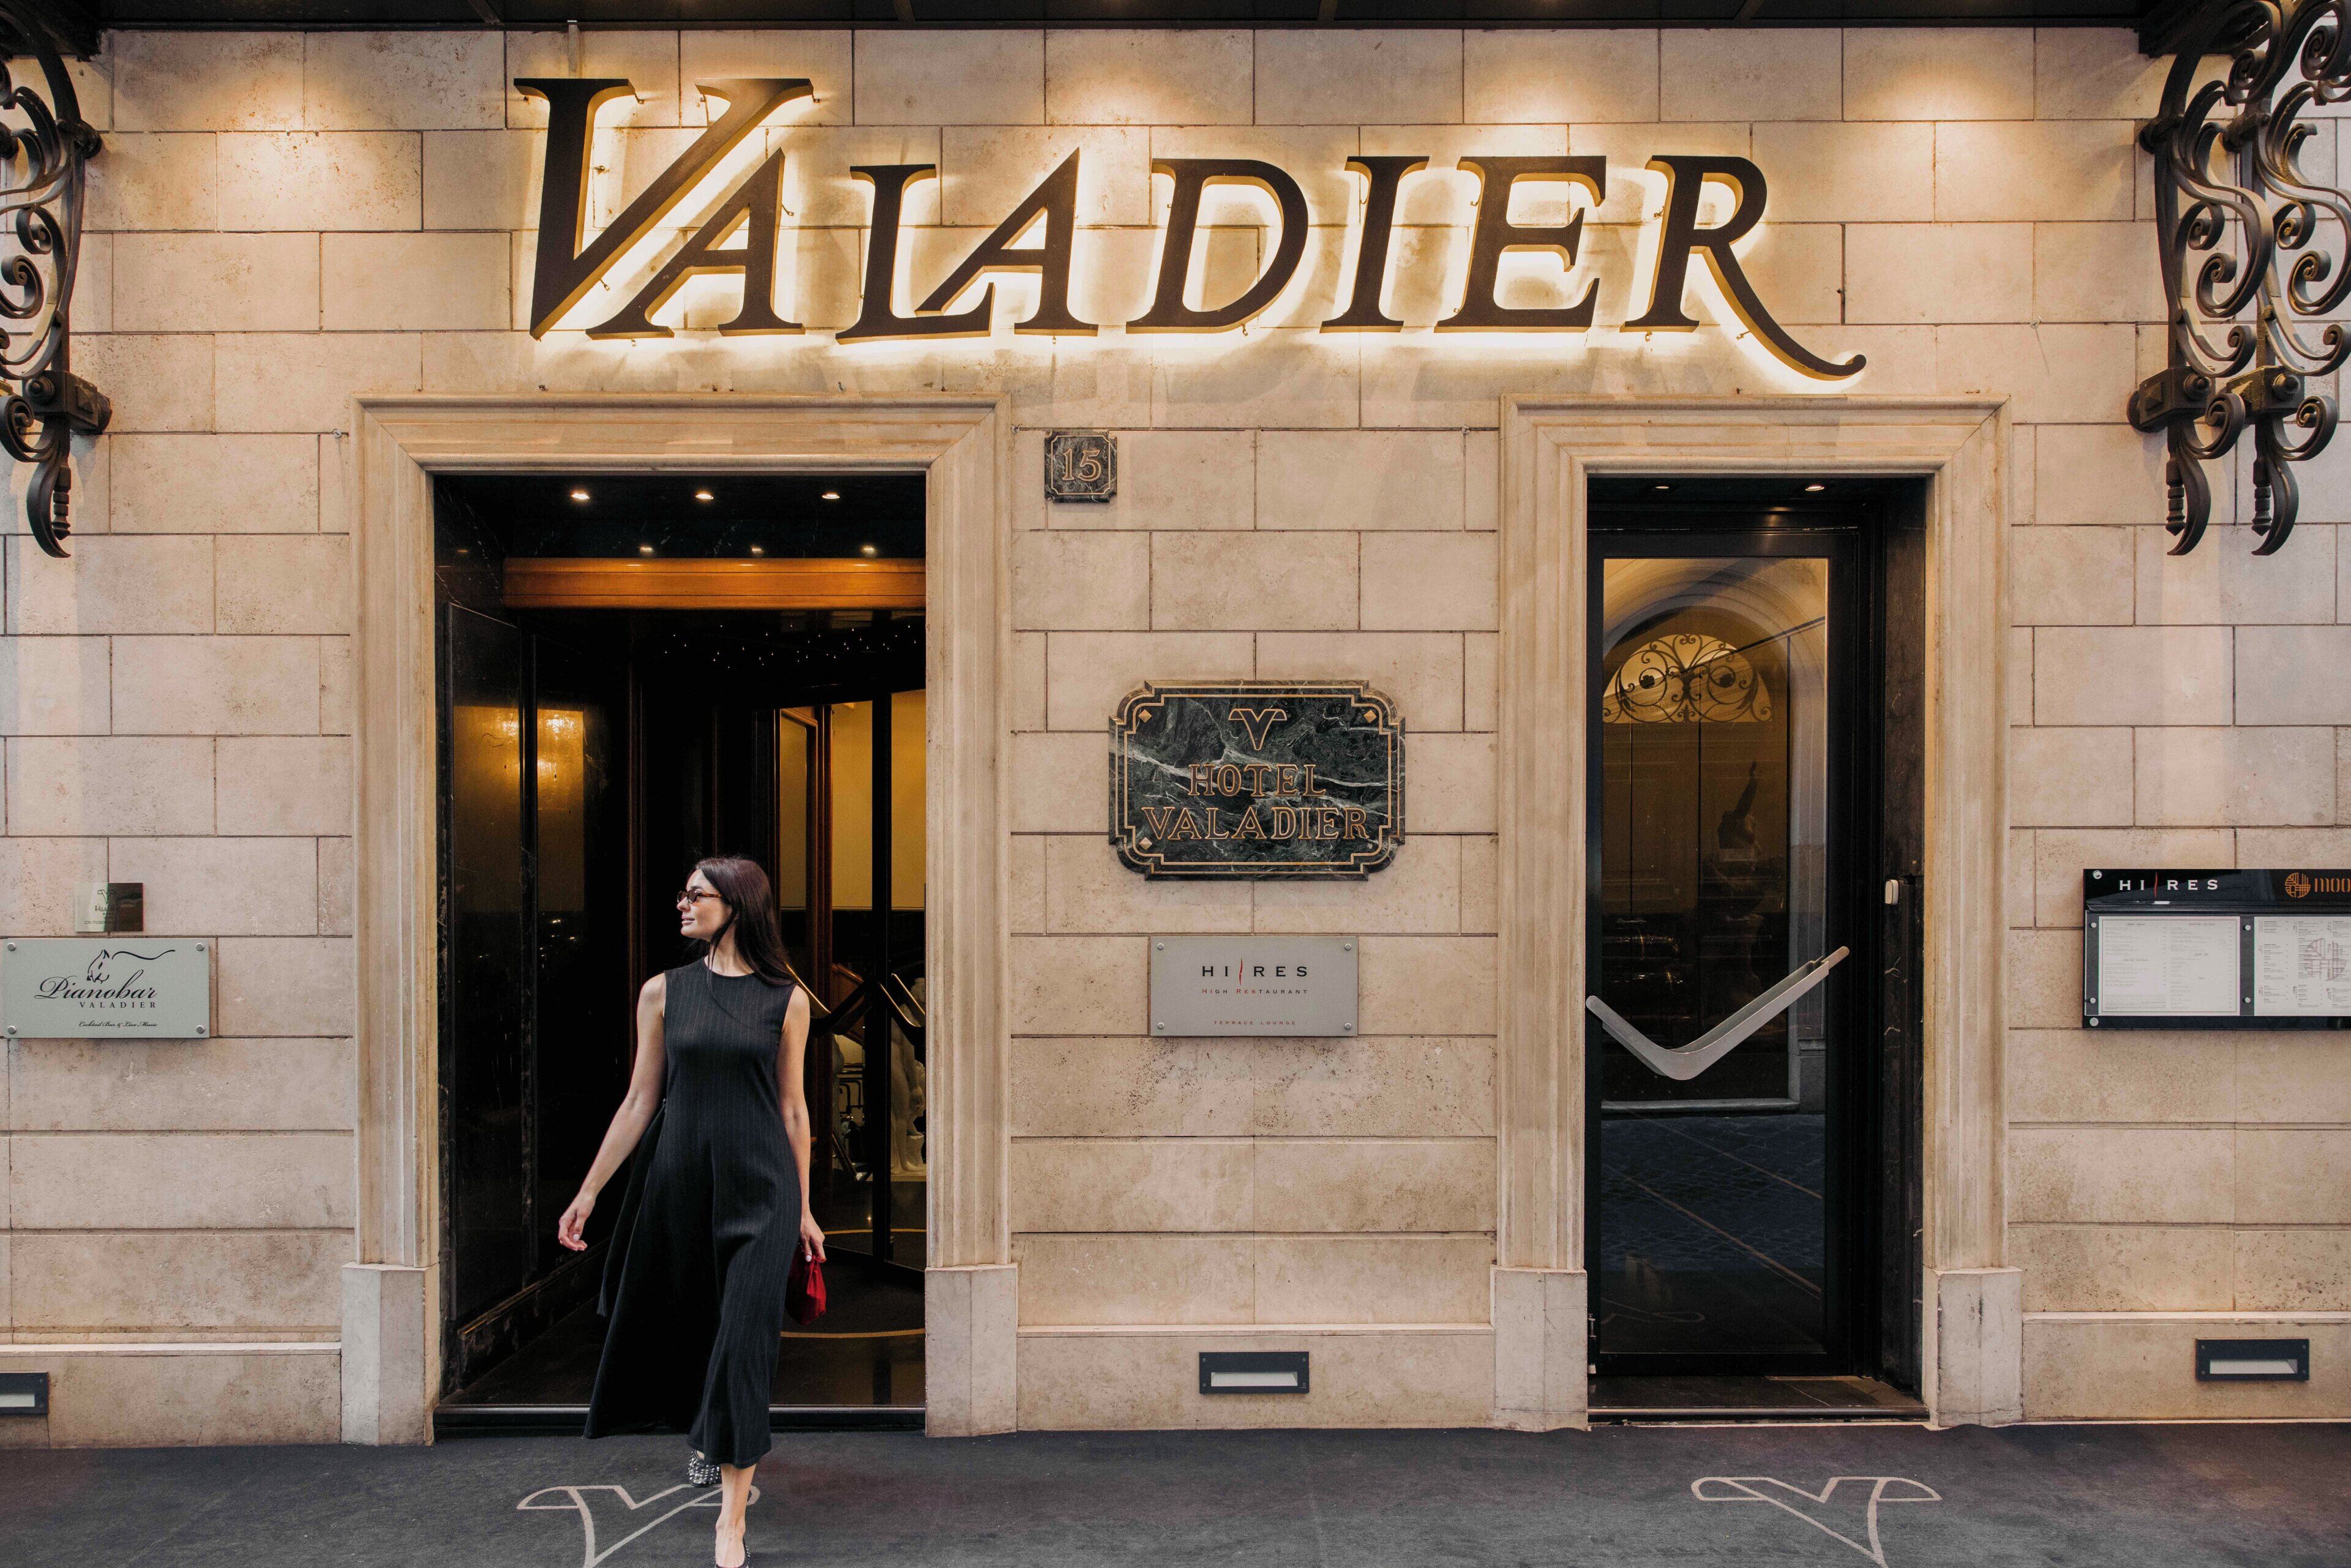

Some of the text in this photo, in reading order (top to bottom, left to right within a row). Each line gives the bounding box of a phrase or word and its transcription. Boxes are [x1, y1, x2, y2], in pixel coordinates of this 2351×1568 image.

[513, 77, 1867, 381] VALADIER
[1062, 448, 1101, 481] 15
[1188, 764, 1326, 797] HOTEL
[1141, 806, 1370, 840] VALADIER
[34, 969, 157, 999] Pianobar
